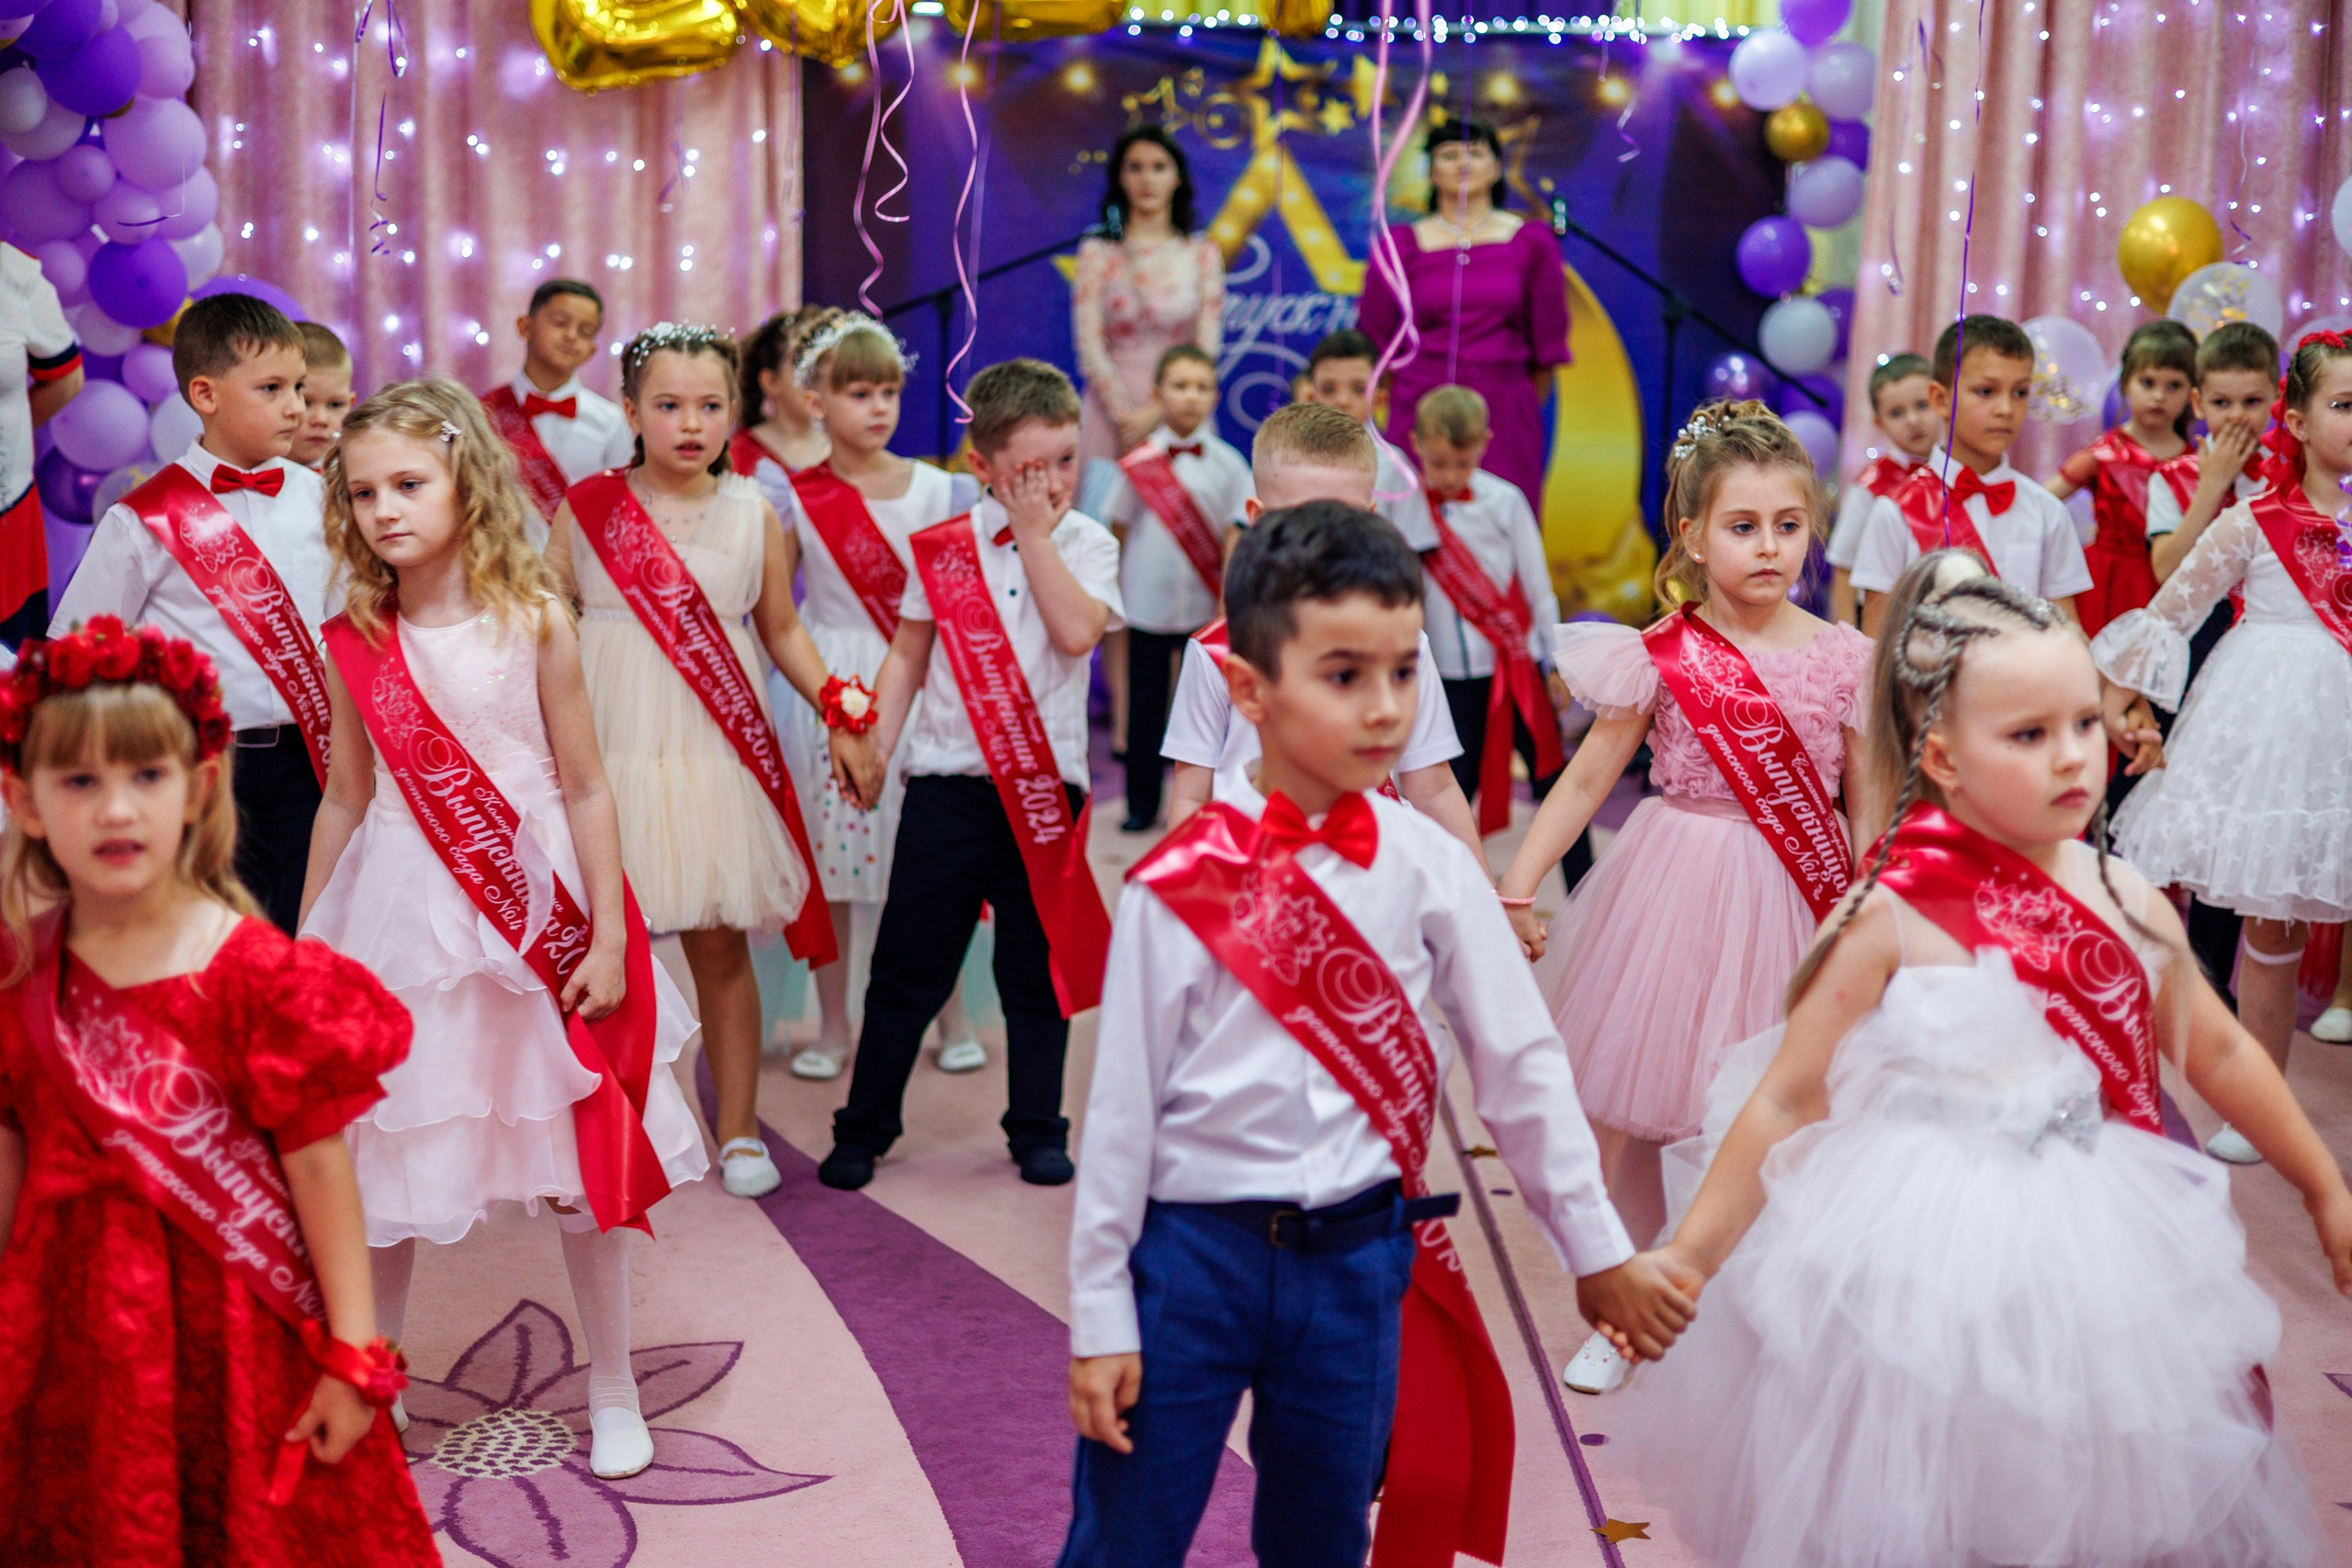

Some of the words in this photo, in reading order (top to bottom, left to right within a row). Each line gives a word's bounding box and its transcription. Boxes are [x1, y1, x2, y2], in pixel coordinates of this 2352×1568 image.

[1015, 774, 1066, 845] 2024
[1698, 724, 1759, 796] детского
[1756, 797, 1784, 836] сада
[1784, 837, 1820, 884] №4
[1722, 688, 1849, 896] Выпускница
[394, 767, 449, 843] детского
[449, 844, 484, 885] сада
[483, 886, 524, 931] №4
[1284, 1005, 1384, 1099] детского
[2047, 993, 2131, 1082] детского
[217, 1222, 269, 1271] сада
